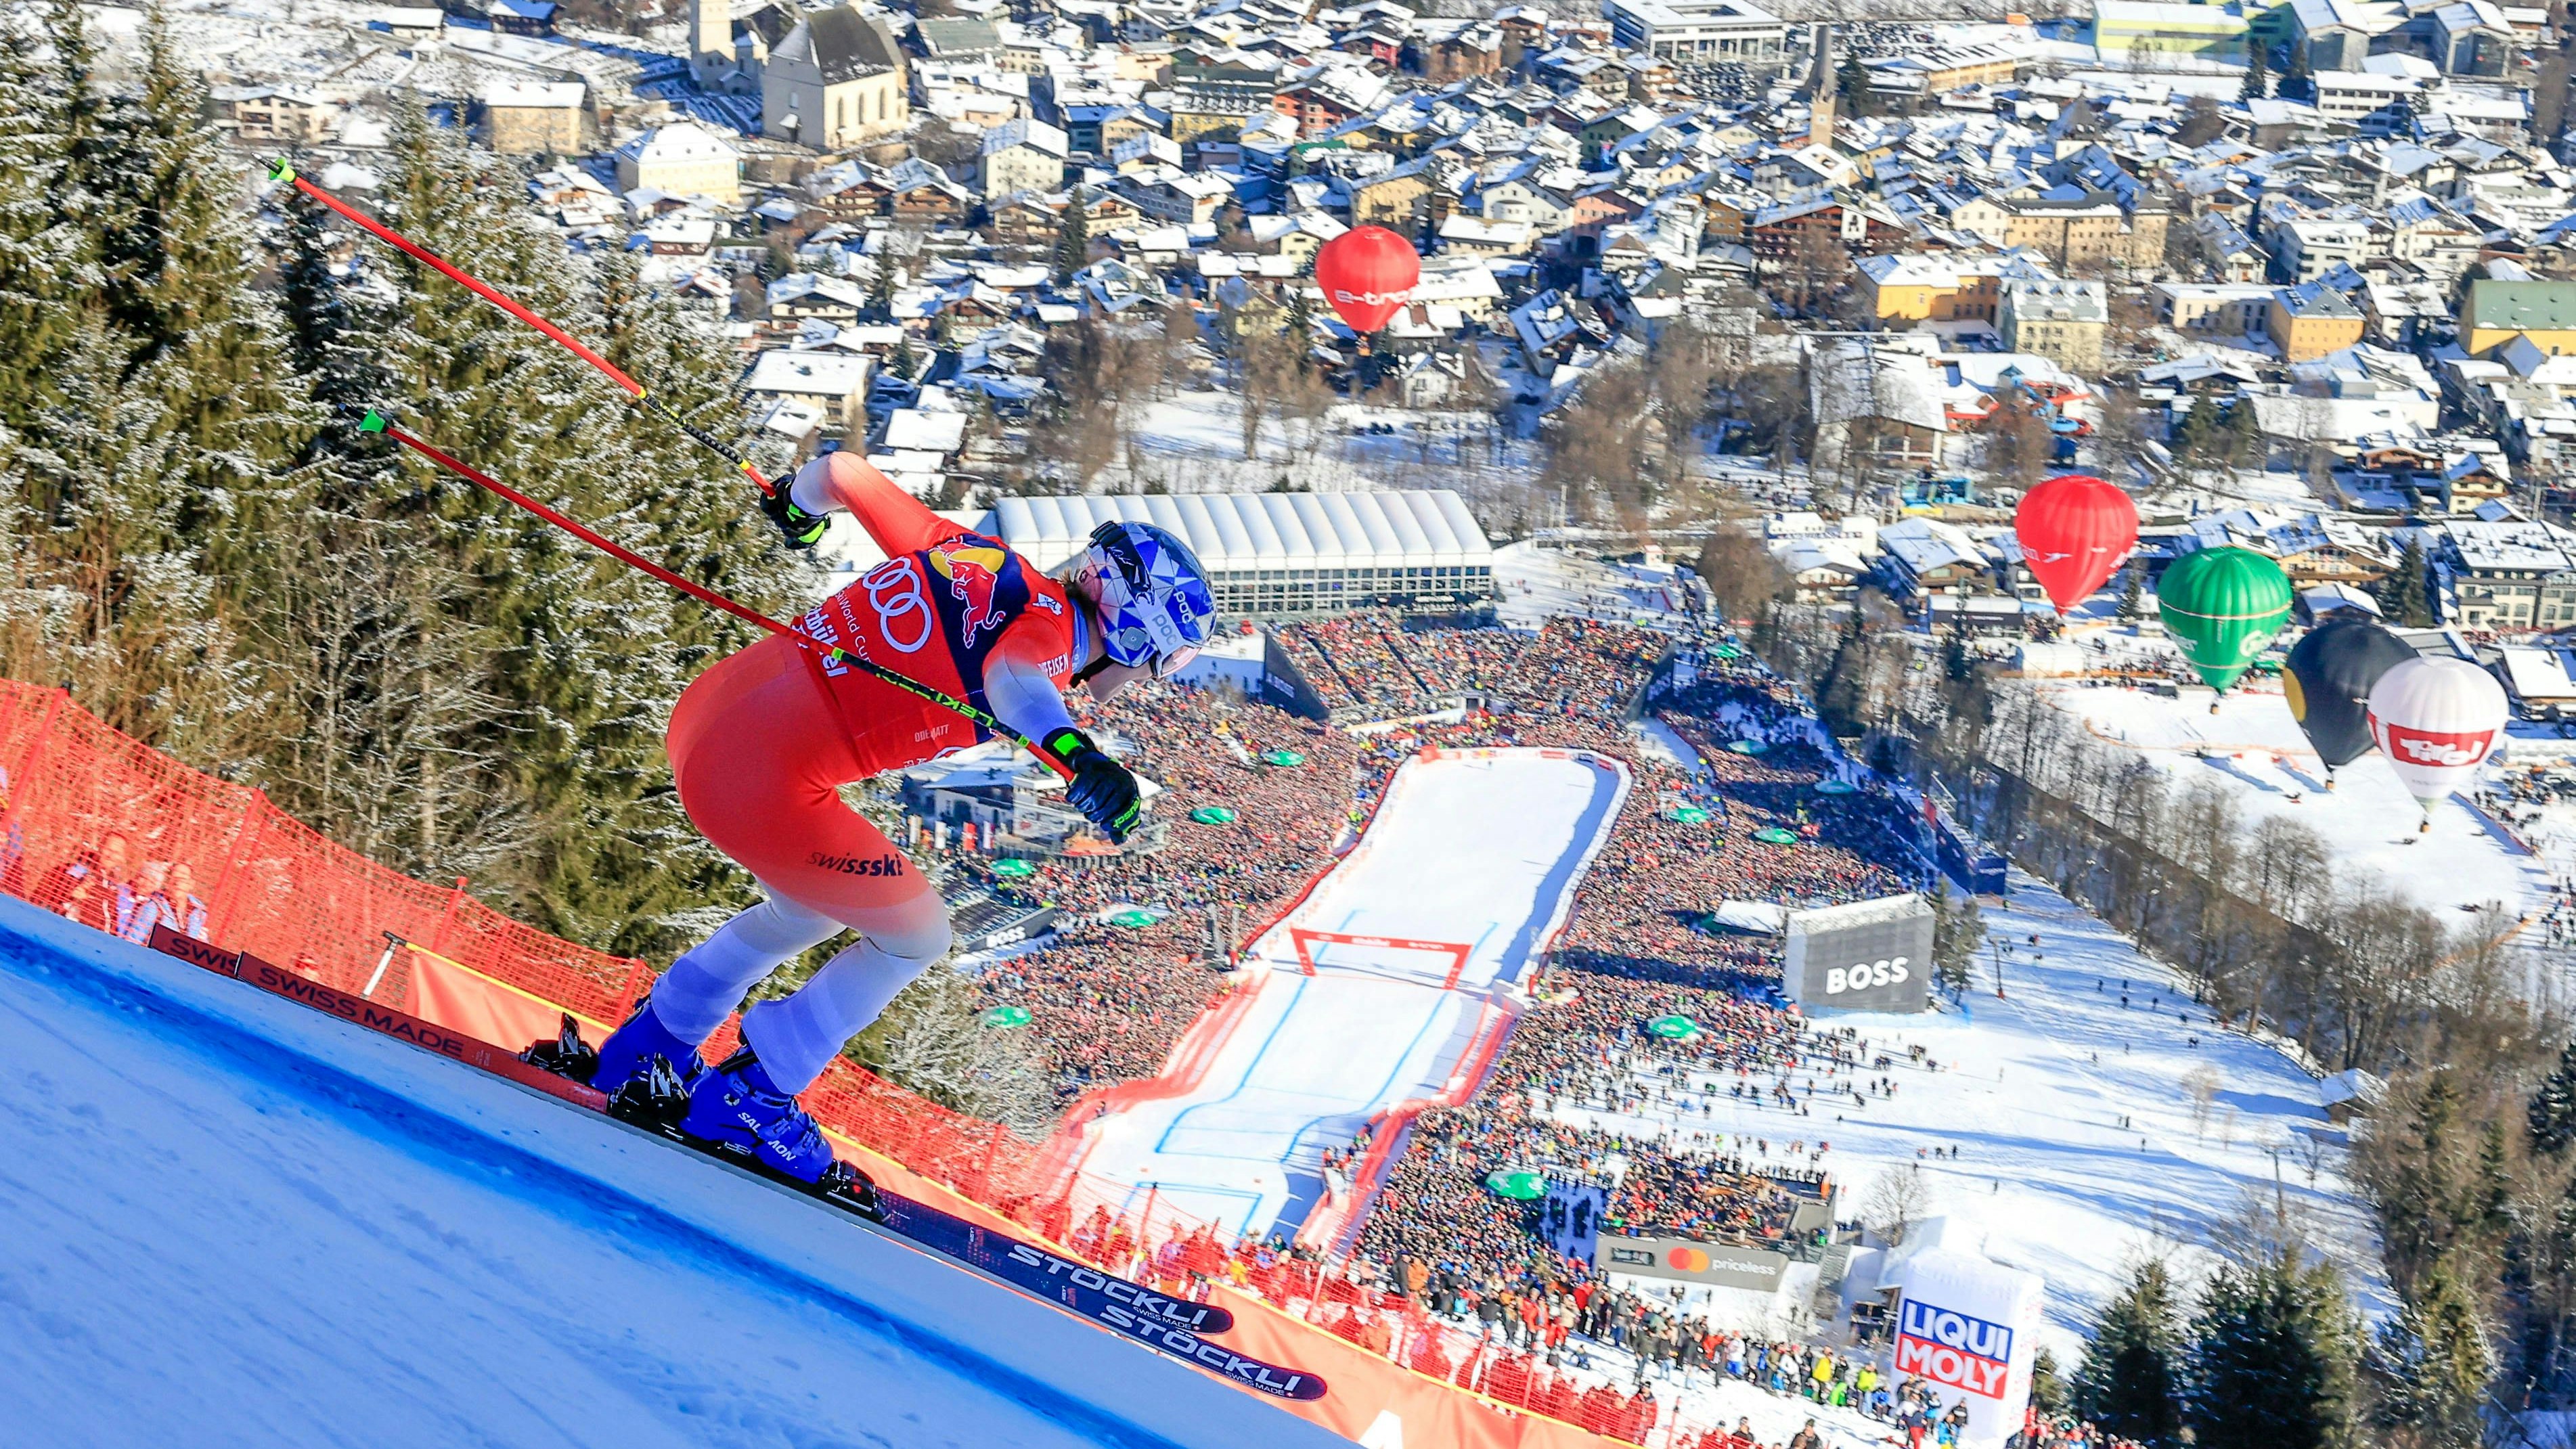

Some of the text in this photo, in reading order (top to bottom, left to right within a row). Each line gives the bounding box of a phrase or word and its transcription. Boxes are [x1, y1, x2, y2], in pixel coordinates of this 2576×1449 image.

[2400, 738, 2485, 765] Tirol
[1825, 956, 1909, 995] BOSS
[258, 967, 464, 1057] SWISS MADE
[1008, 1244, 1208, 1325] STÖCKLI
[1712, 1258, 1777, 1276] priceless
[1133, 1306, 1192, 1330] SWISS MADE
[1904, 1301, 2010, 1362] LIQUI
[1100, 1305, 1302, 1391] STÖCKLI
[1899, 1337, 2007, 1395] MOLY
[1225, 1371, 1285, 1396] SWISS MADE
